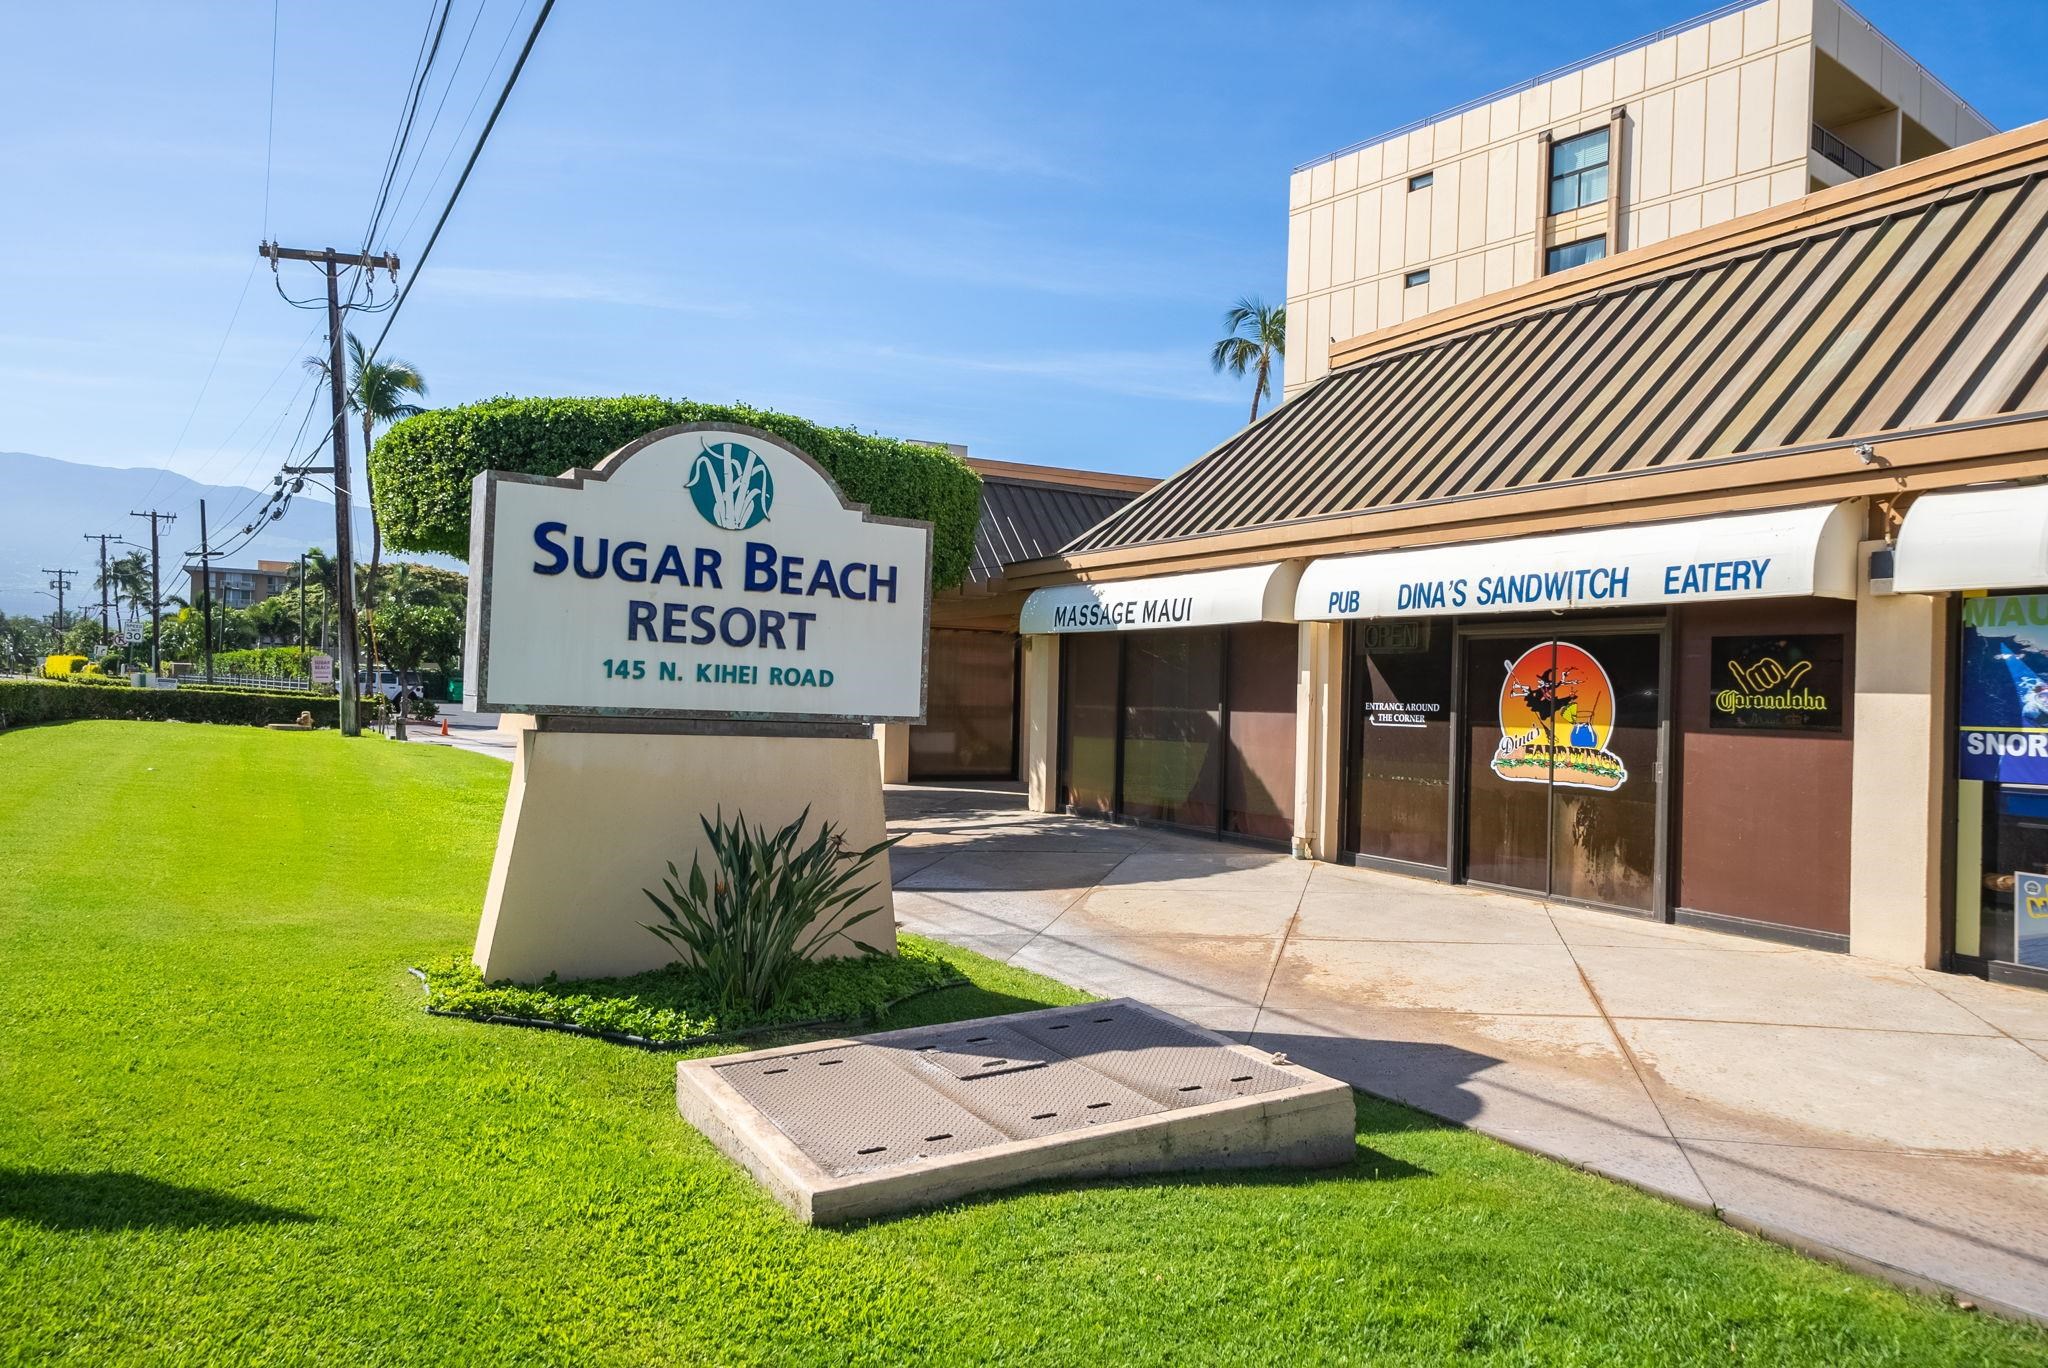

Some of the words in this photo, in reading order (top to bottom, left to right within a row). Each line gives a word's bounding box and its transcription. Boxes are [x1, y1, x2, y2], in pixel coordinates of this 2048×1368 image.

[533, 521, 723, 589] SUGAR
[744, 541, 898, 604] BEACH
[1328, 590, 1360, 614] PUB
[1396, 578, 1468, 611] DINA'S
[1476, 567, 1629, 606] SANDWITCH
[1664, 558, 1771, 596] EATERY
[627, 600, 817, 651] RESORT
[1054, 601, 1138, 628] MASSAGE
[1142, 597, 1193, 623] MAUI
[126, 632, 141, 640] 30
[1366, 624, 1416, 648] OPEN
[603, 659, 646, 680] 145
[659, 662, 683, 682] N.
[697, 663, 758, 685] KIHEI
[770, 667, 834, 688] ROAD
[1365, 702, 1404, 711] ENTRANCE
[1405, 703, 1440, 712] AROUND
[1716, 687, 1827, 714] Coronaloha
[1378, 713, 1393, 722] THE
[1393, 713, 1425, 723] CORNER
[1501, 723, 1540, 754] Dina's
